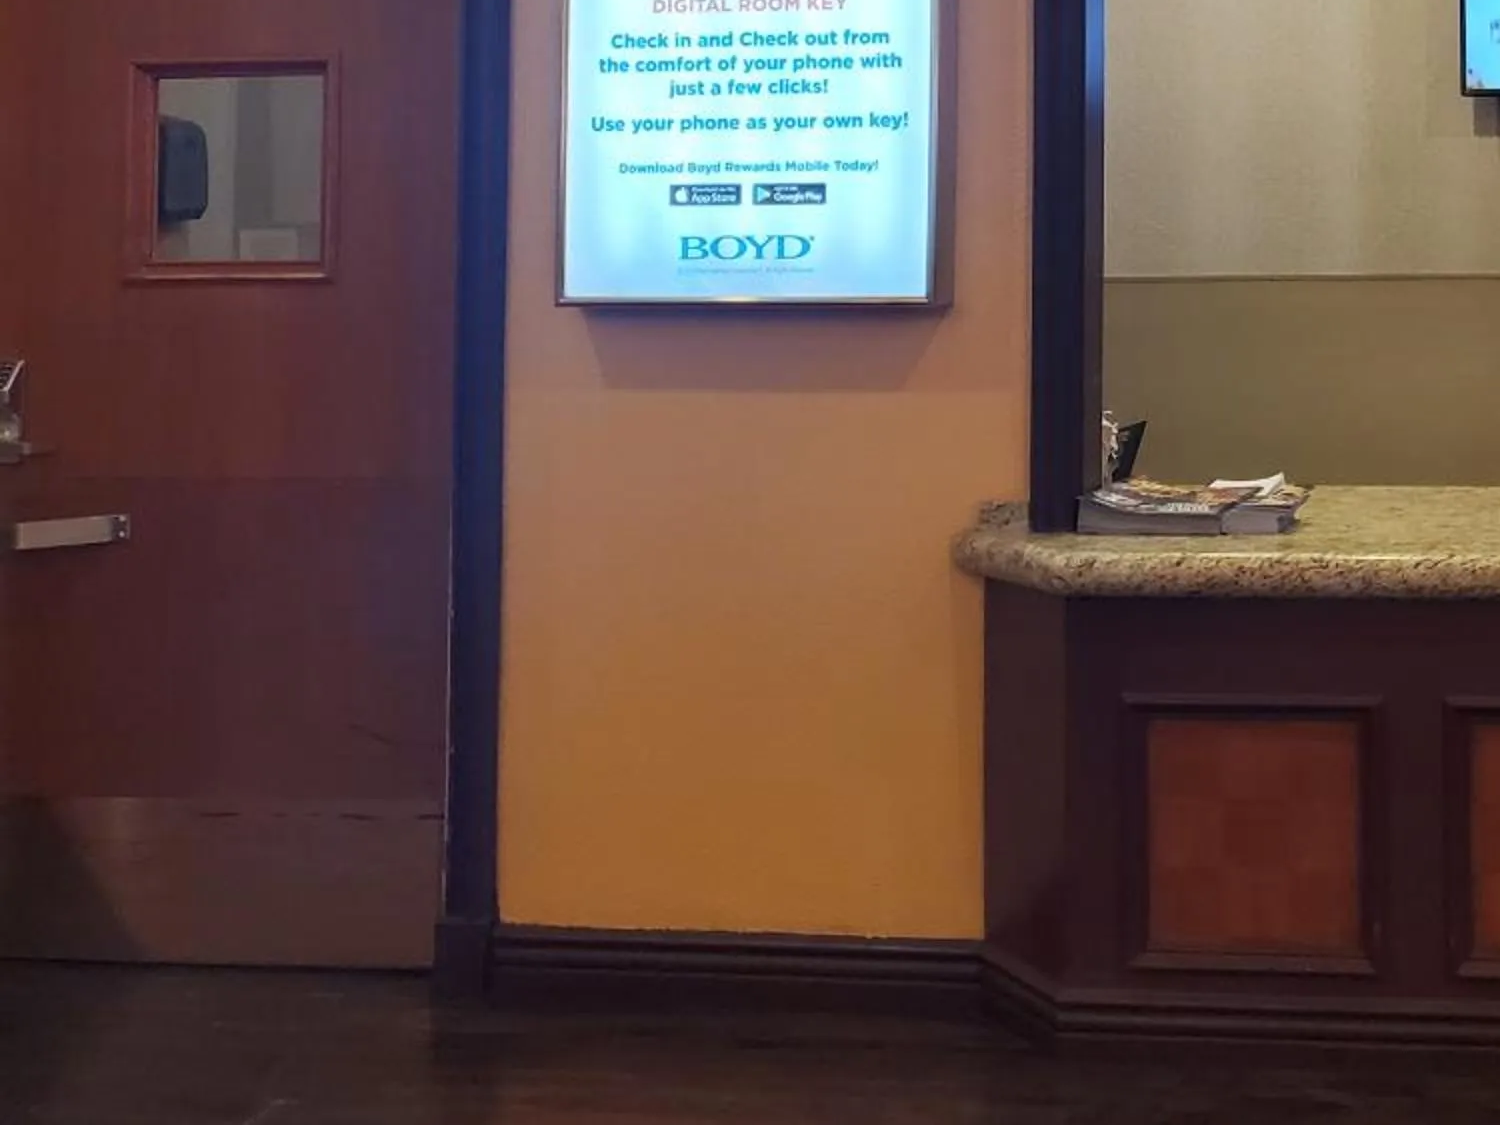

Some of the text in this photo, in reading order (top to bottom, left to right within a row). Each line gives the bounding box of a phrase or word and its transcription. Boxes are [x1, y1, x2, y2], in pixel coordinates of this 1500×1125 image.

[610, 29, 891, 49] Check in and Check out from
[599, 52, 903, 74] the comfort of your phone with
[668, 78, 829, 100] just a few clicks!
[591, 111, 910, 135] Use your phone as your own key!
[618, 159, 880, 176] Download Boyd Rewards Mobile Today!
[691, 192, 737, 204] App Store
[679, 234, 812, 260] BOYD
